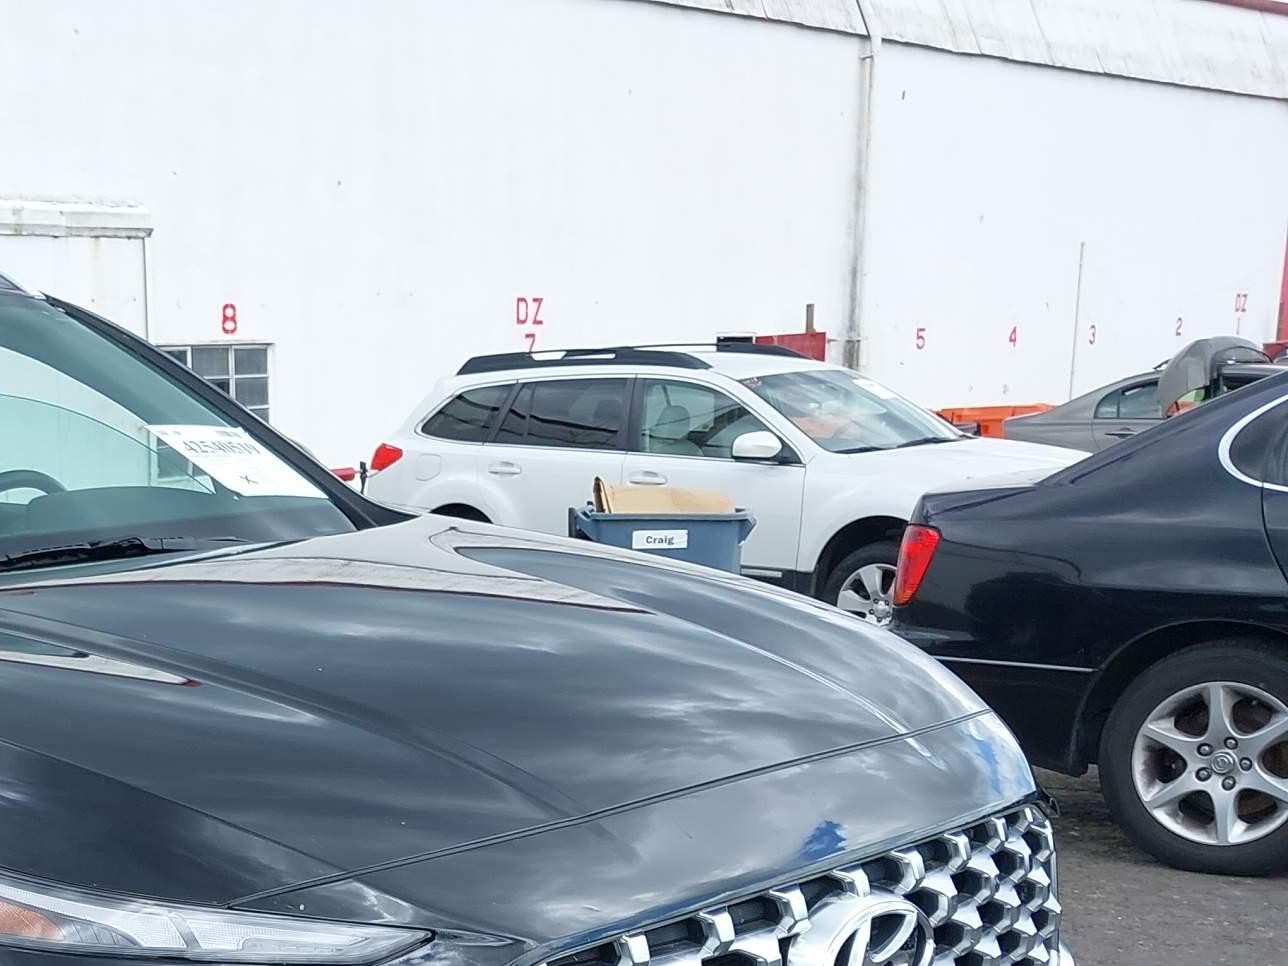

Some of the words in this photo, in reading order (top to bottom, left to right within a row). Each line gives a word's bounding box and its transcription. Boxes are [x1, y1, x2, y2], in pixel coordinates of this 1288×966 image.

[222, 303, 237, 335] 8
[516, 297, 544, 325] DZ
[1008, 325, 1017, 348] 4
[1088, 324, 1096, 345] 3
[1175, 317, 1183, 336] 2
[524, 333, 536, 353] 7
[915, 327, 926, 350] 5
[645, 535, 675, 546] Craig
